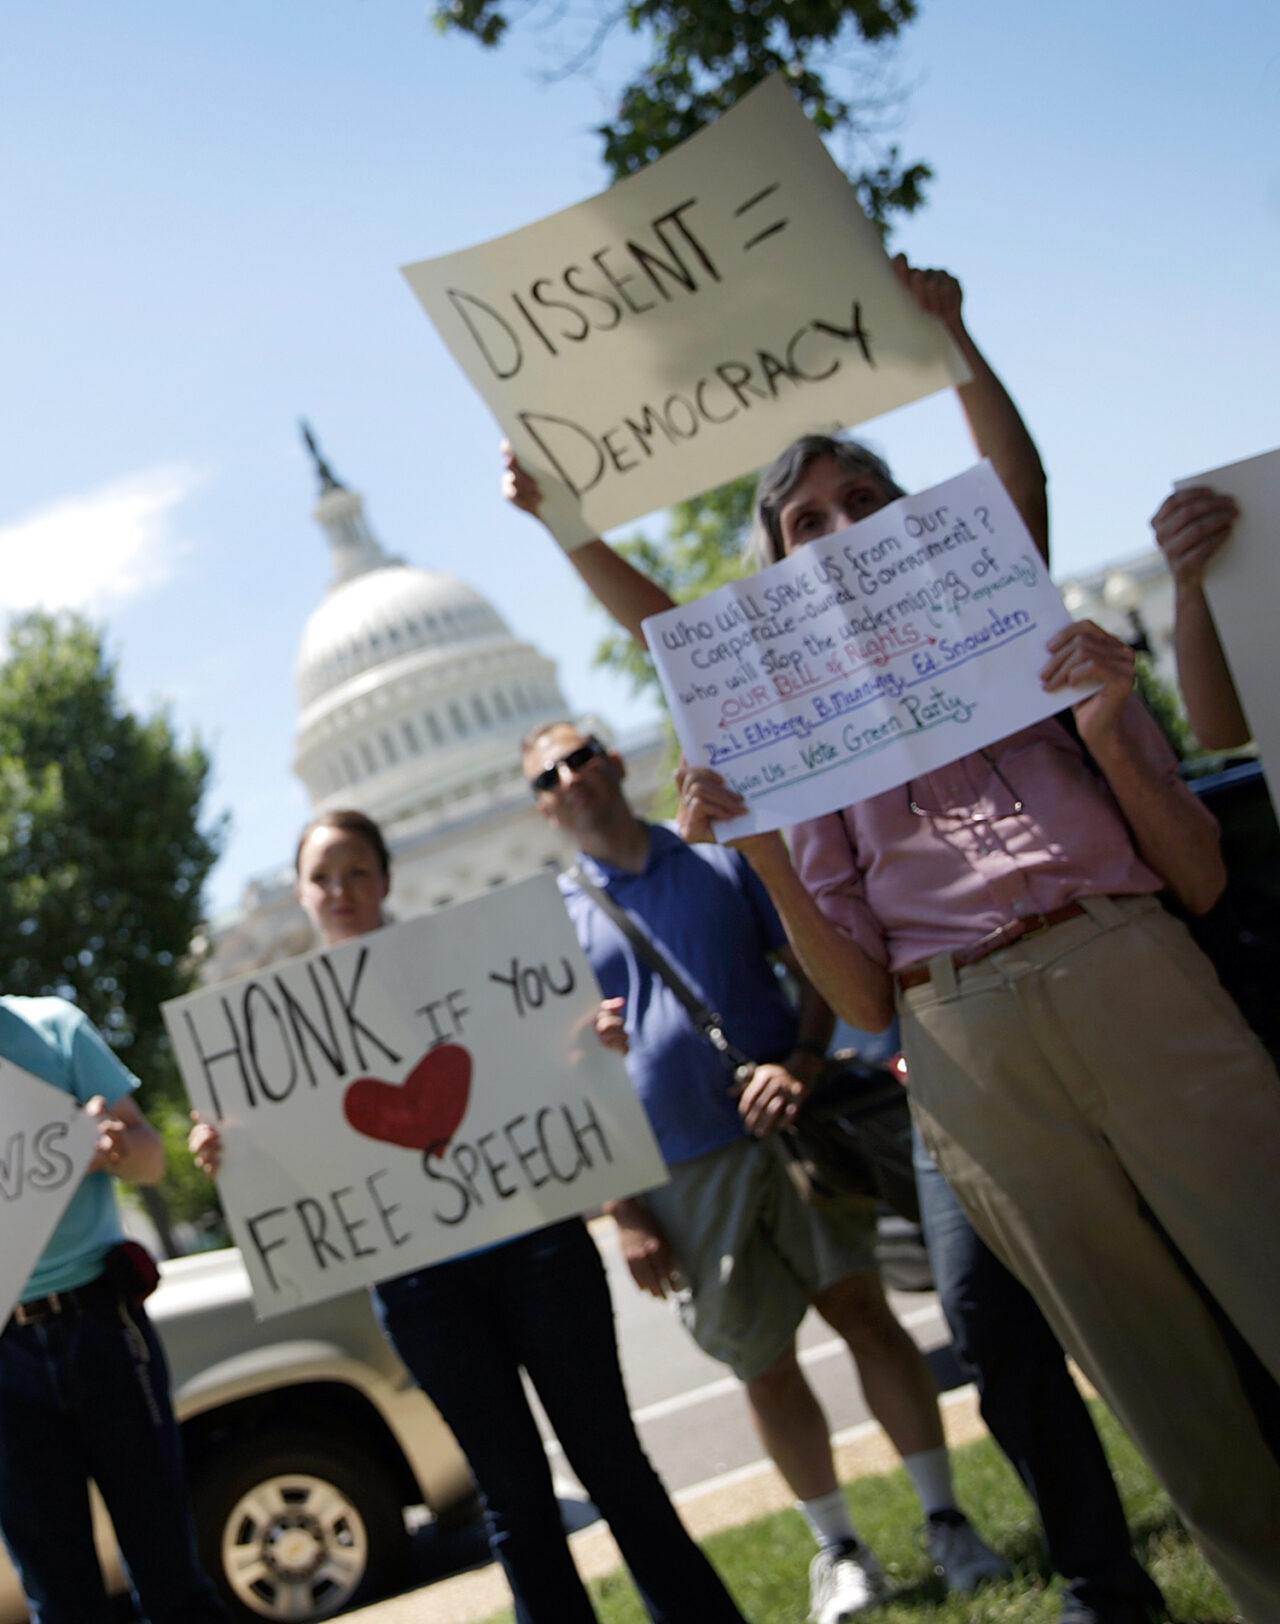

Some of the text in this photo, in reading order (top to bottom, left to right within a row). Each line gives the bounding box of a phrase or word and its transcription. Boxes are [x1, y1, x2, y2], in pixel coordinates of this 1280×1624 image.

[445, 198, 724, 382] DISSENT
[517, 300, 877, 498] DEMOCRACY
[803, 634, 837, 656] the
[971, 546, 999, 577] of
[844, 536, 901, 570] from
[939, 607, 1031, 661] Snowden
[721, 686, 769, 717] OUR
[842, 714, 904, 753] Green
[183, 946, 577, 1119] HONK IF YOU
[245, 1096, 615, 1293] FREE SPEECH
